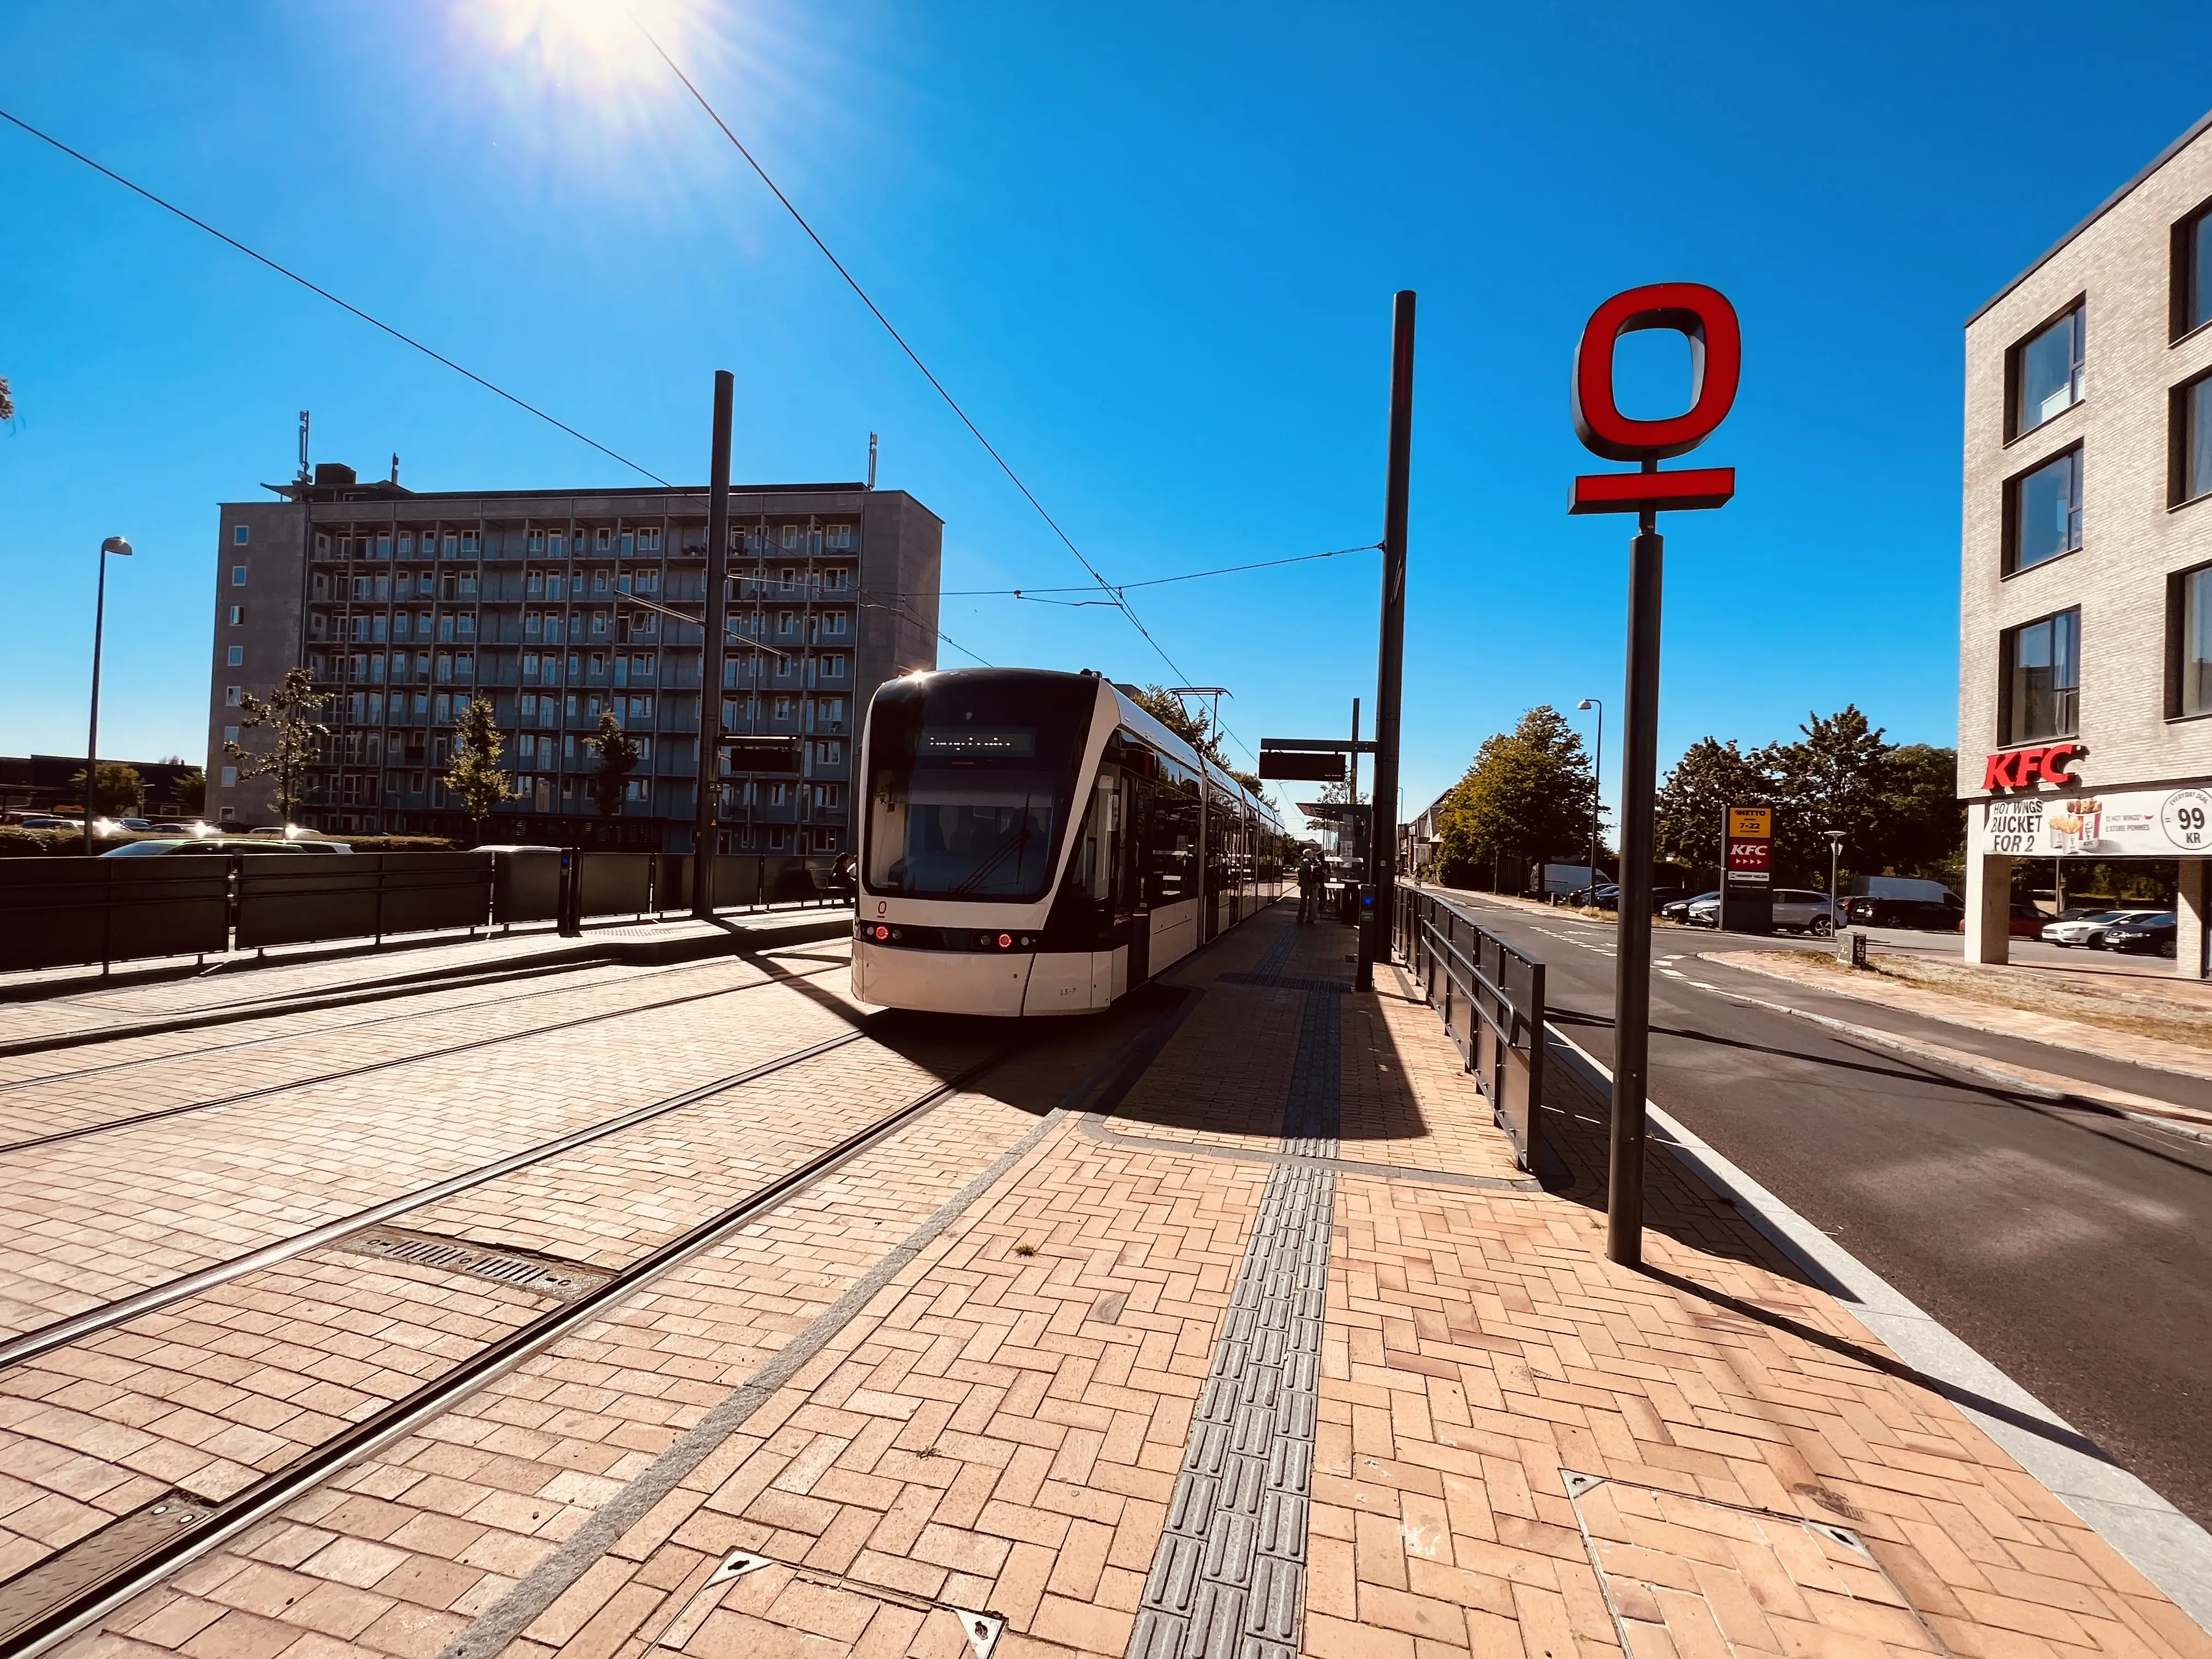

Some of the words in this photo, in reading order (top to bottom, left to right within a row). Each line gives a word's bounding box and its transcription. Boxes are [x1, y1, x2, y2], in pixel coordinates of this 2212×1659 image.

[1981, 744, 2073, 789] KFC
[1994, 803, 2009, 814] HOT
[2013, 800, 2042, 814] WNGS
[1990, 815, 2042, 833] BUCKET
[2178, 808, 2205, 830] 99
[1994, 835, 2022, 851] FOR
[2024, 835, 2034, 851] 2
[2186, 833, 2201, 843] KR
[1730, 845, 1768, 855] KFC
